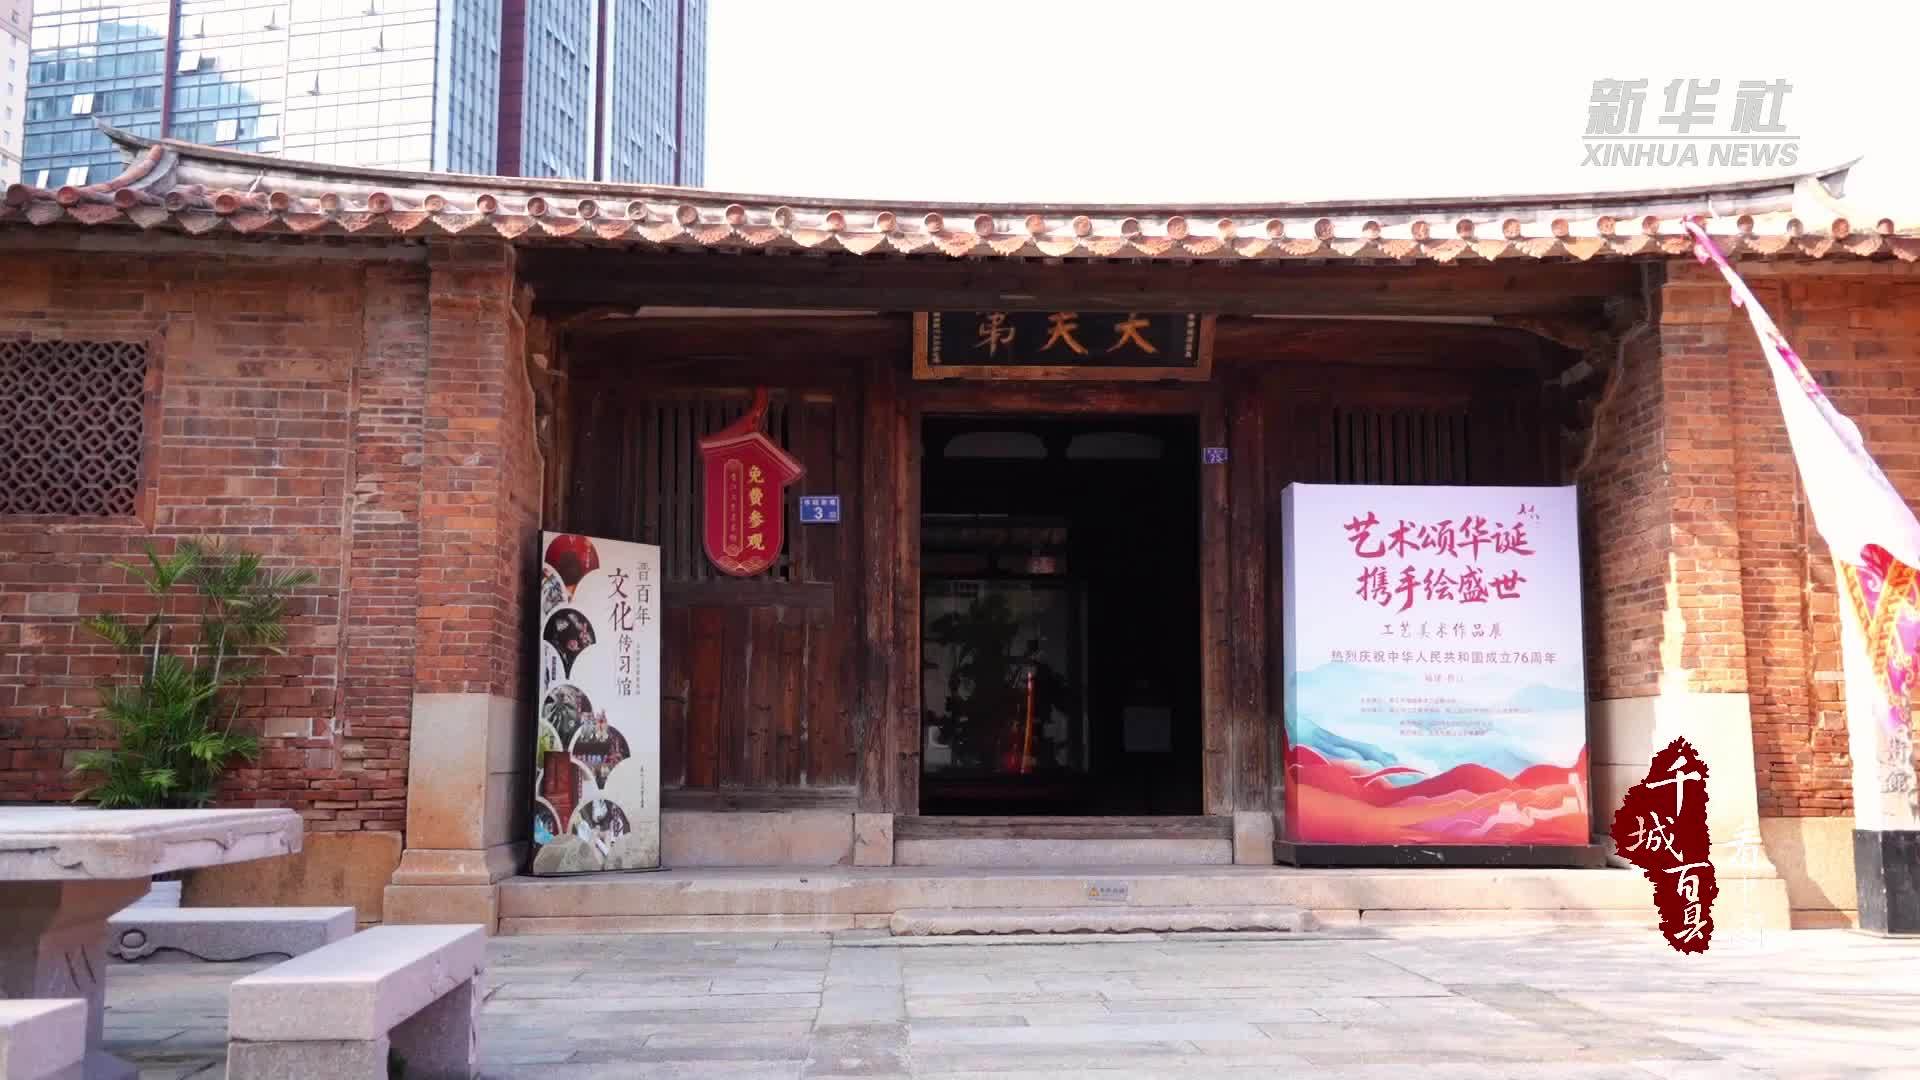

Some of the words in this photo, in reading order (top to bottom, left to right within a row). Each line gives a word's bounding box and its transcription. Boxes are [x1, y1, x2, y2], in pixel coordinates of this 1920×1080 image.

[745, 464, 766, 551] 免费参观
[814, 506, 824, 521] 3
[1343, 512, 1535, 561] 艺术颂华诞
[1355, 565, 1527, 614] 携手绘盛世
[607, 567, 634, 697] 文化传习馆
[1380, 621, 1503, 640] 工艺美术作品展
[1331, 650, 1557, 664] 热烈庆祝中华人民共和国成立76周年
